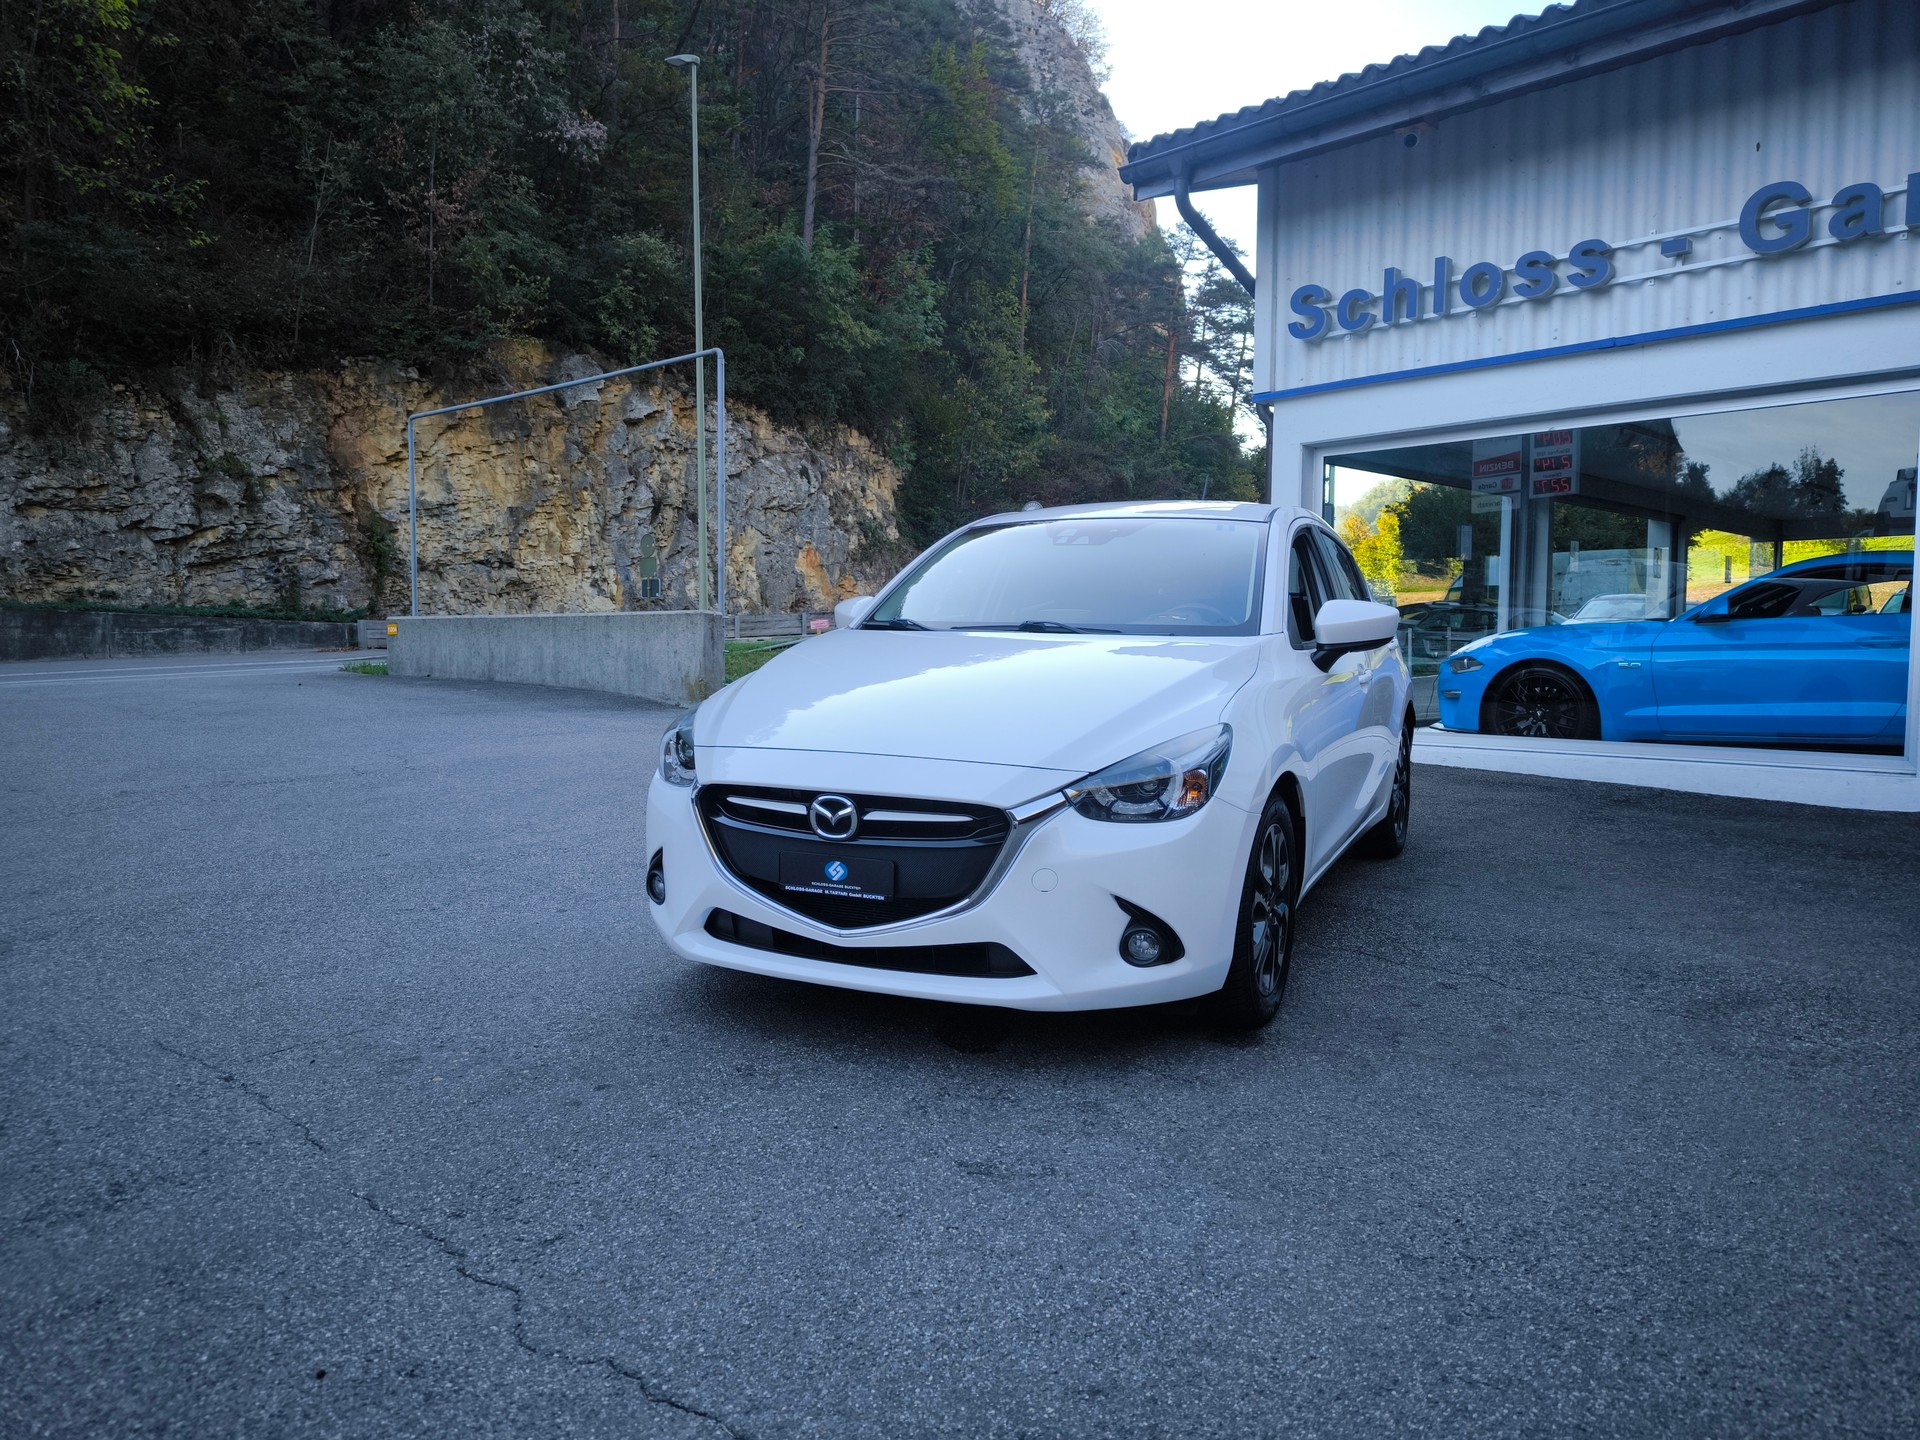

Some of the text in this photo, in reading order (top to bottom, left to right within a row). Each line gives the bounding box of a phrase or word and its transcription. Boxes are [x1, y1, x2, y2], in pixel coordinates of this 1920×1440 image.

[1287, 239, 1614, 343] Schloss
[784, 885, 823, 894] SCHLOSS-GARAGE
[862, 893, 885, 901] BUCKTEN
